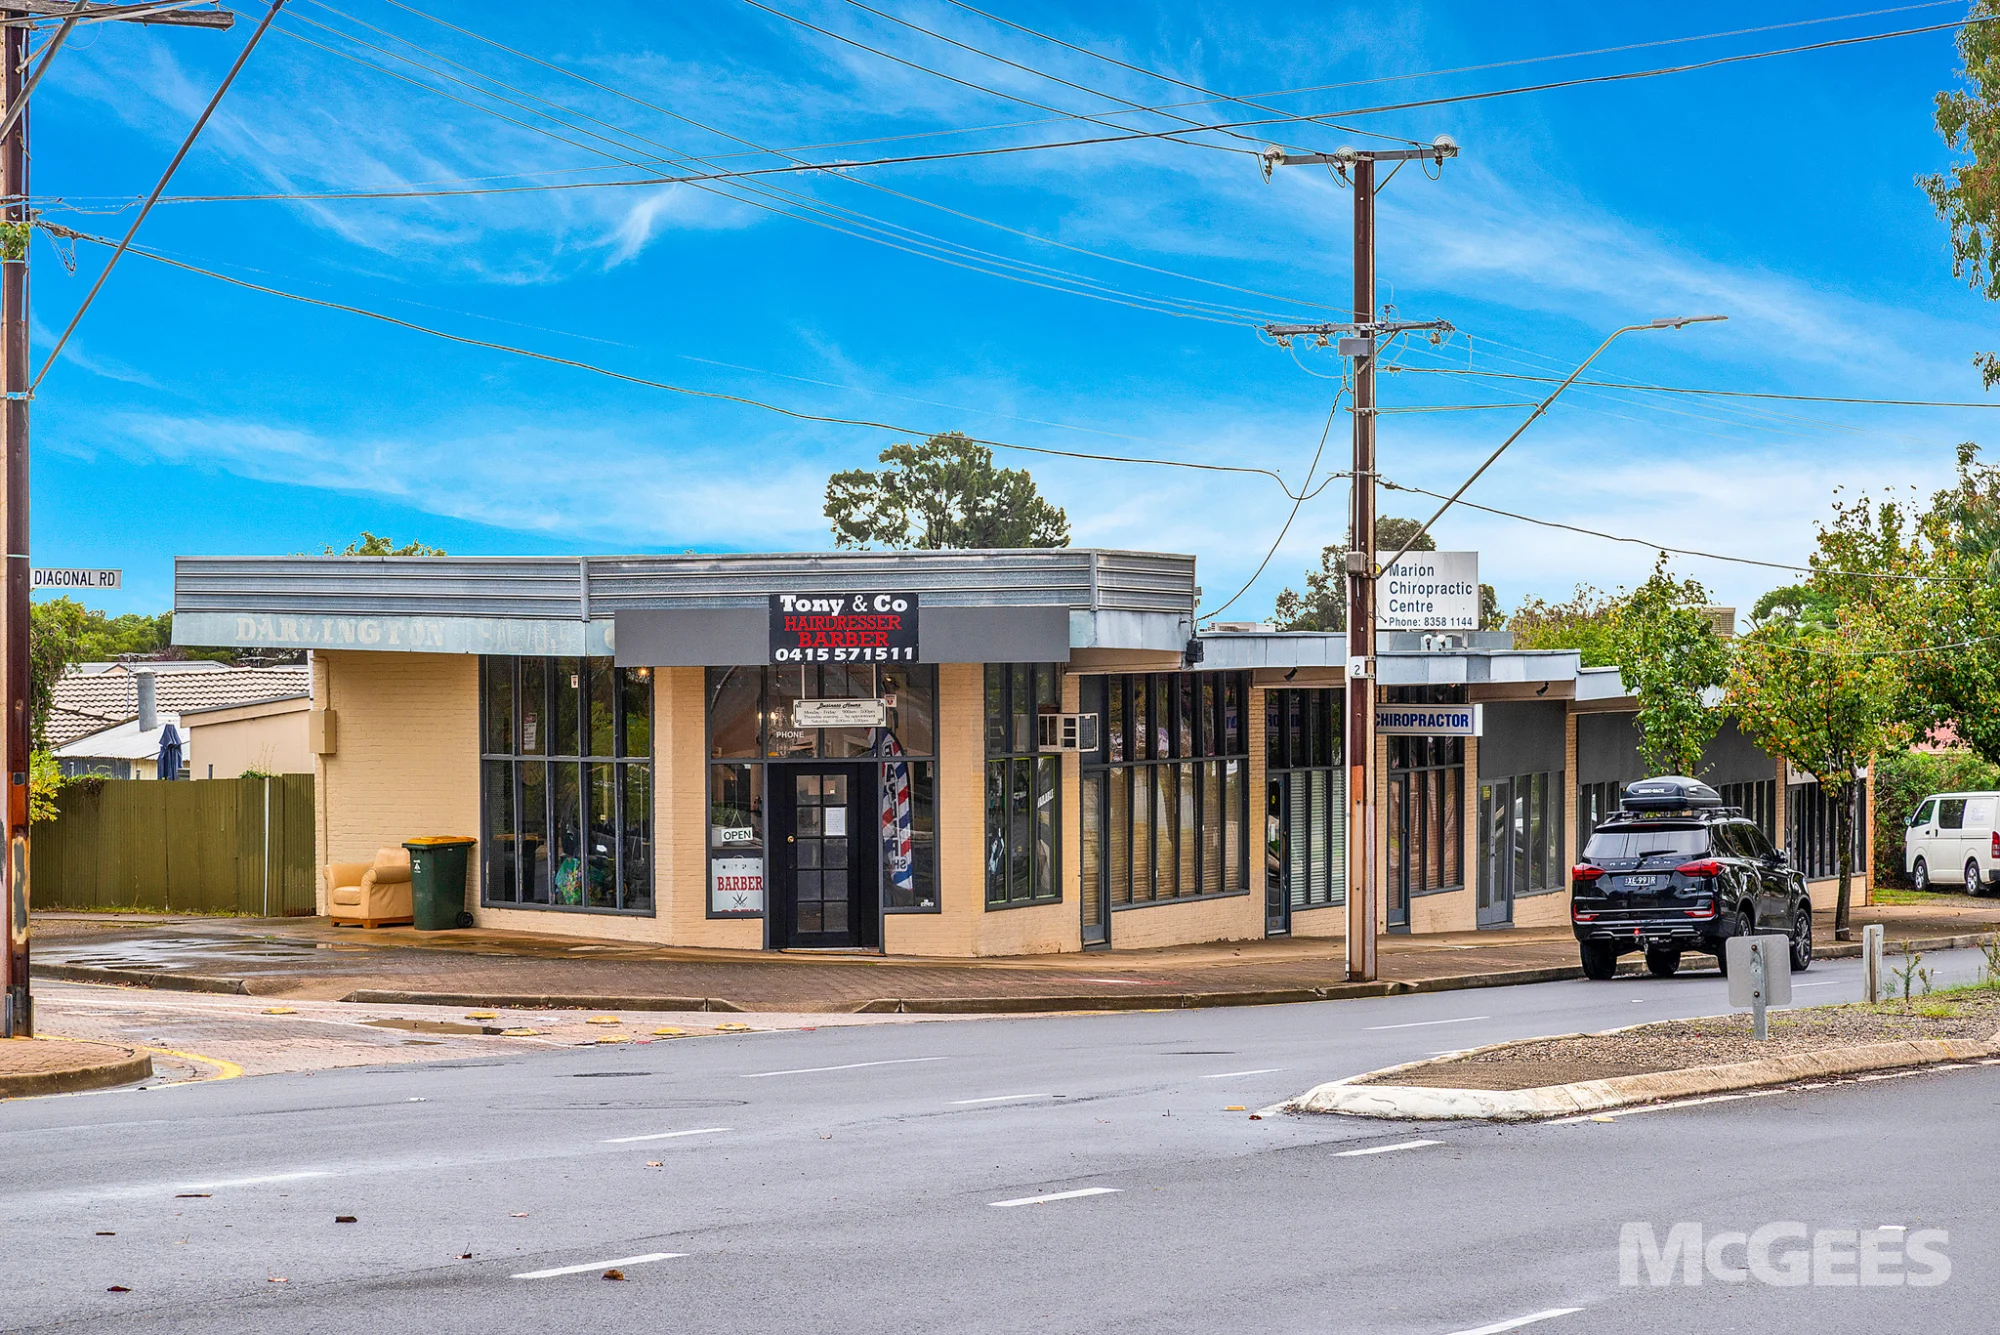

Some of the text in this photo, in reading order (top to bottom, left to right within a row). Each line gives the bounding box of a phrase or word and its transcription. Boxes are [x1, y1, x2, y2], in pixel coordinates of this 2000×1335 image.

[1389, 563, 1434, 577] Marion
[34, 570, 115, 586] DIAGONAL RD
[1389, 581, 1473, 598] Chiropractic
[780, 594, 908, 616] Tony & Co
[1389, 599, 1433, 613] Centre
[784, 615, 902, 631] HAIRDRESSER
[1389, 617, 1473, 627] Phone: 8358 1144
[236, 617, 446, 646] DARLINGTON
[798, 632, 889, 647] BARBER
[775, 647, 913, 661] 0415 571511
[1354, 664, 1361, 676] 2
[1376, 713, 1469, 728] CHIROPRACTOR
[776, 731, 804, 739] PHONE
[723, 830, 751, 841] OPEN
[717, 876, 763, 891] BARBER
